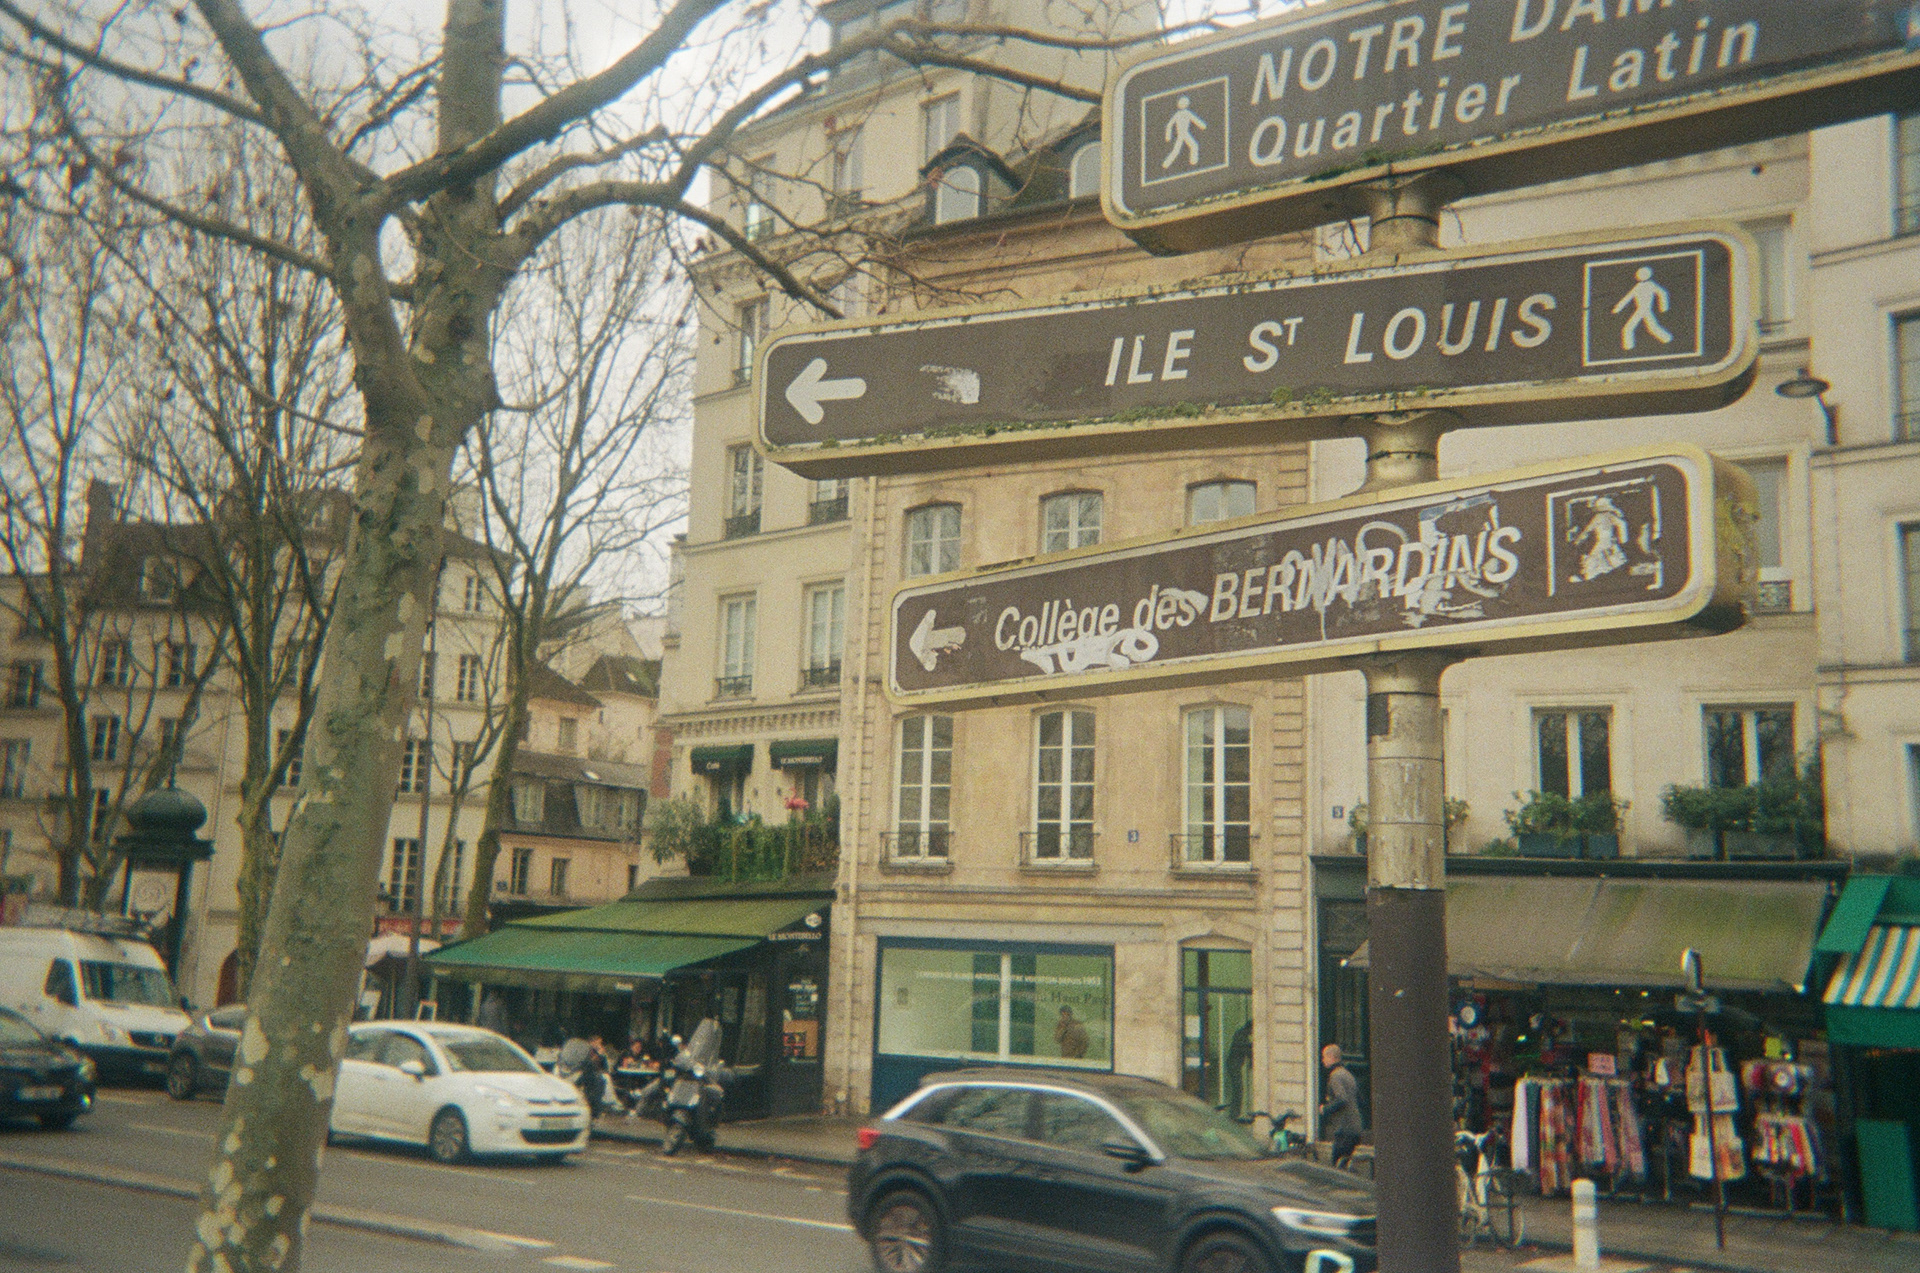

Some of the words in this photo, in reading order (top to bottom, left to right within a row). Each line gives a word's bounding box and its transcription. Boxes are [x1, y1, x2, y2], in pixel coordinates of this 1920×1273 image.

[1249, 74, 1521, 167] Quartier
[1566, 16, 1760, 101] Latin
[1251, 2, 1470, 105] NOTRE
[1105, 329, 1195, 386] ILE
[1344, 293, 1557, 364] LOUIS
[995, 599, 1120, 651] Collège
[1133, 584, 1196, 632] des
